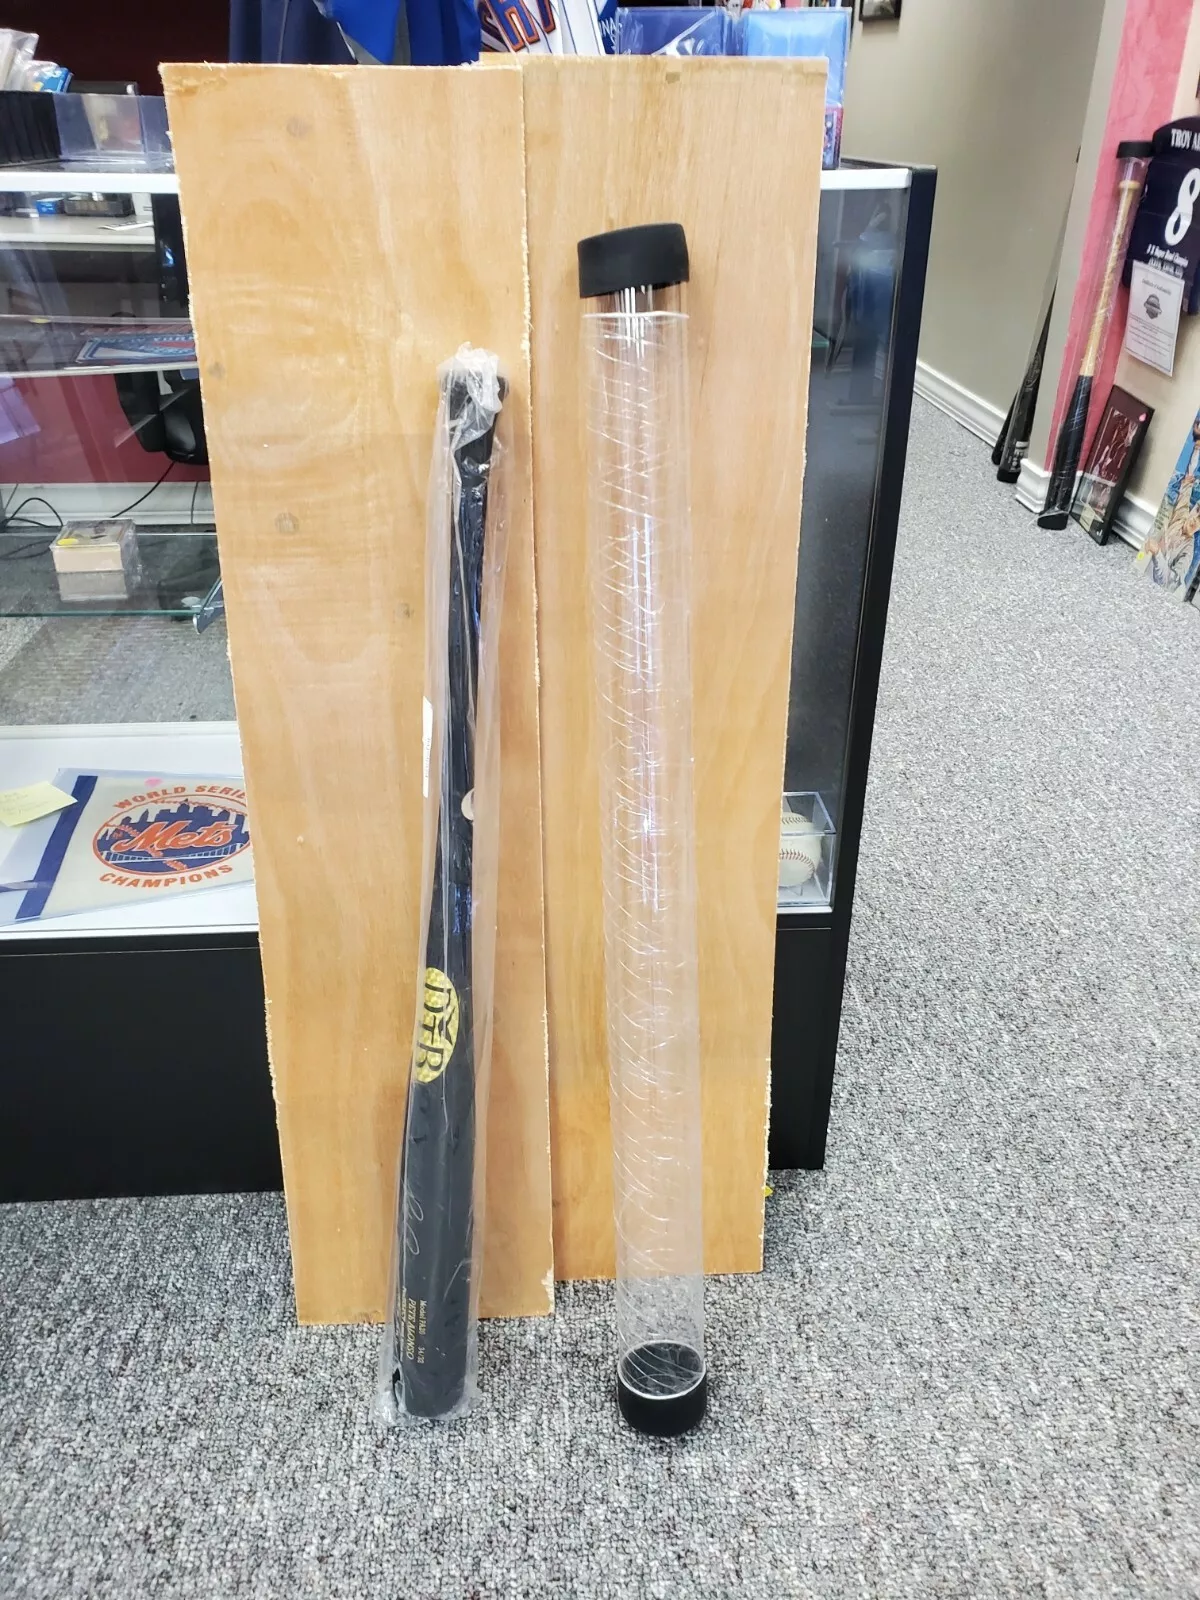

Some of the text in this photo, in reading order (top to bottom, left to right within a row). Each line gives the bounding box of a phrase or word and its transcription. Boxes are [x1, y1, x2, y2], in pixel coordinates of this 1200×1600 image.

[1171, 128, 1192, 149] TROY
[1164, 167, 1200, 247] 8
[114, 786, 186, 808] WORLD
[111, 820, 238, 854] Mets
[99, 864, 234, 888] CHAMPIONS
[419, 1300, 427, 1320] Model
[407, 1298, 417, 1360] PETE ALONSO
